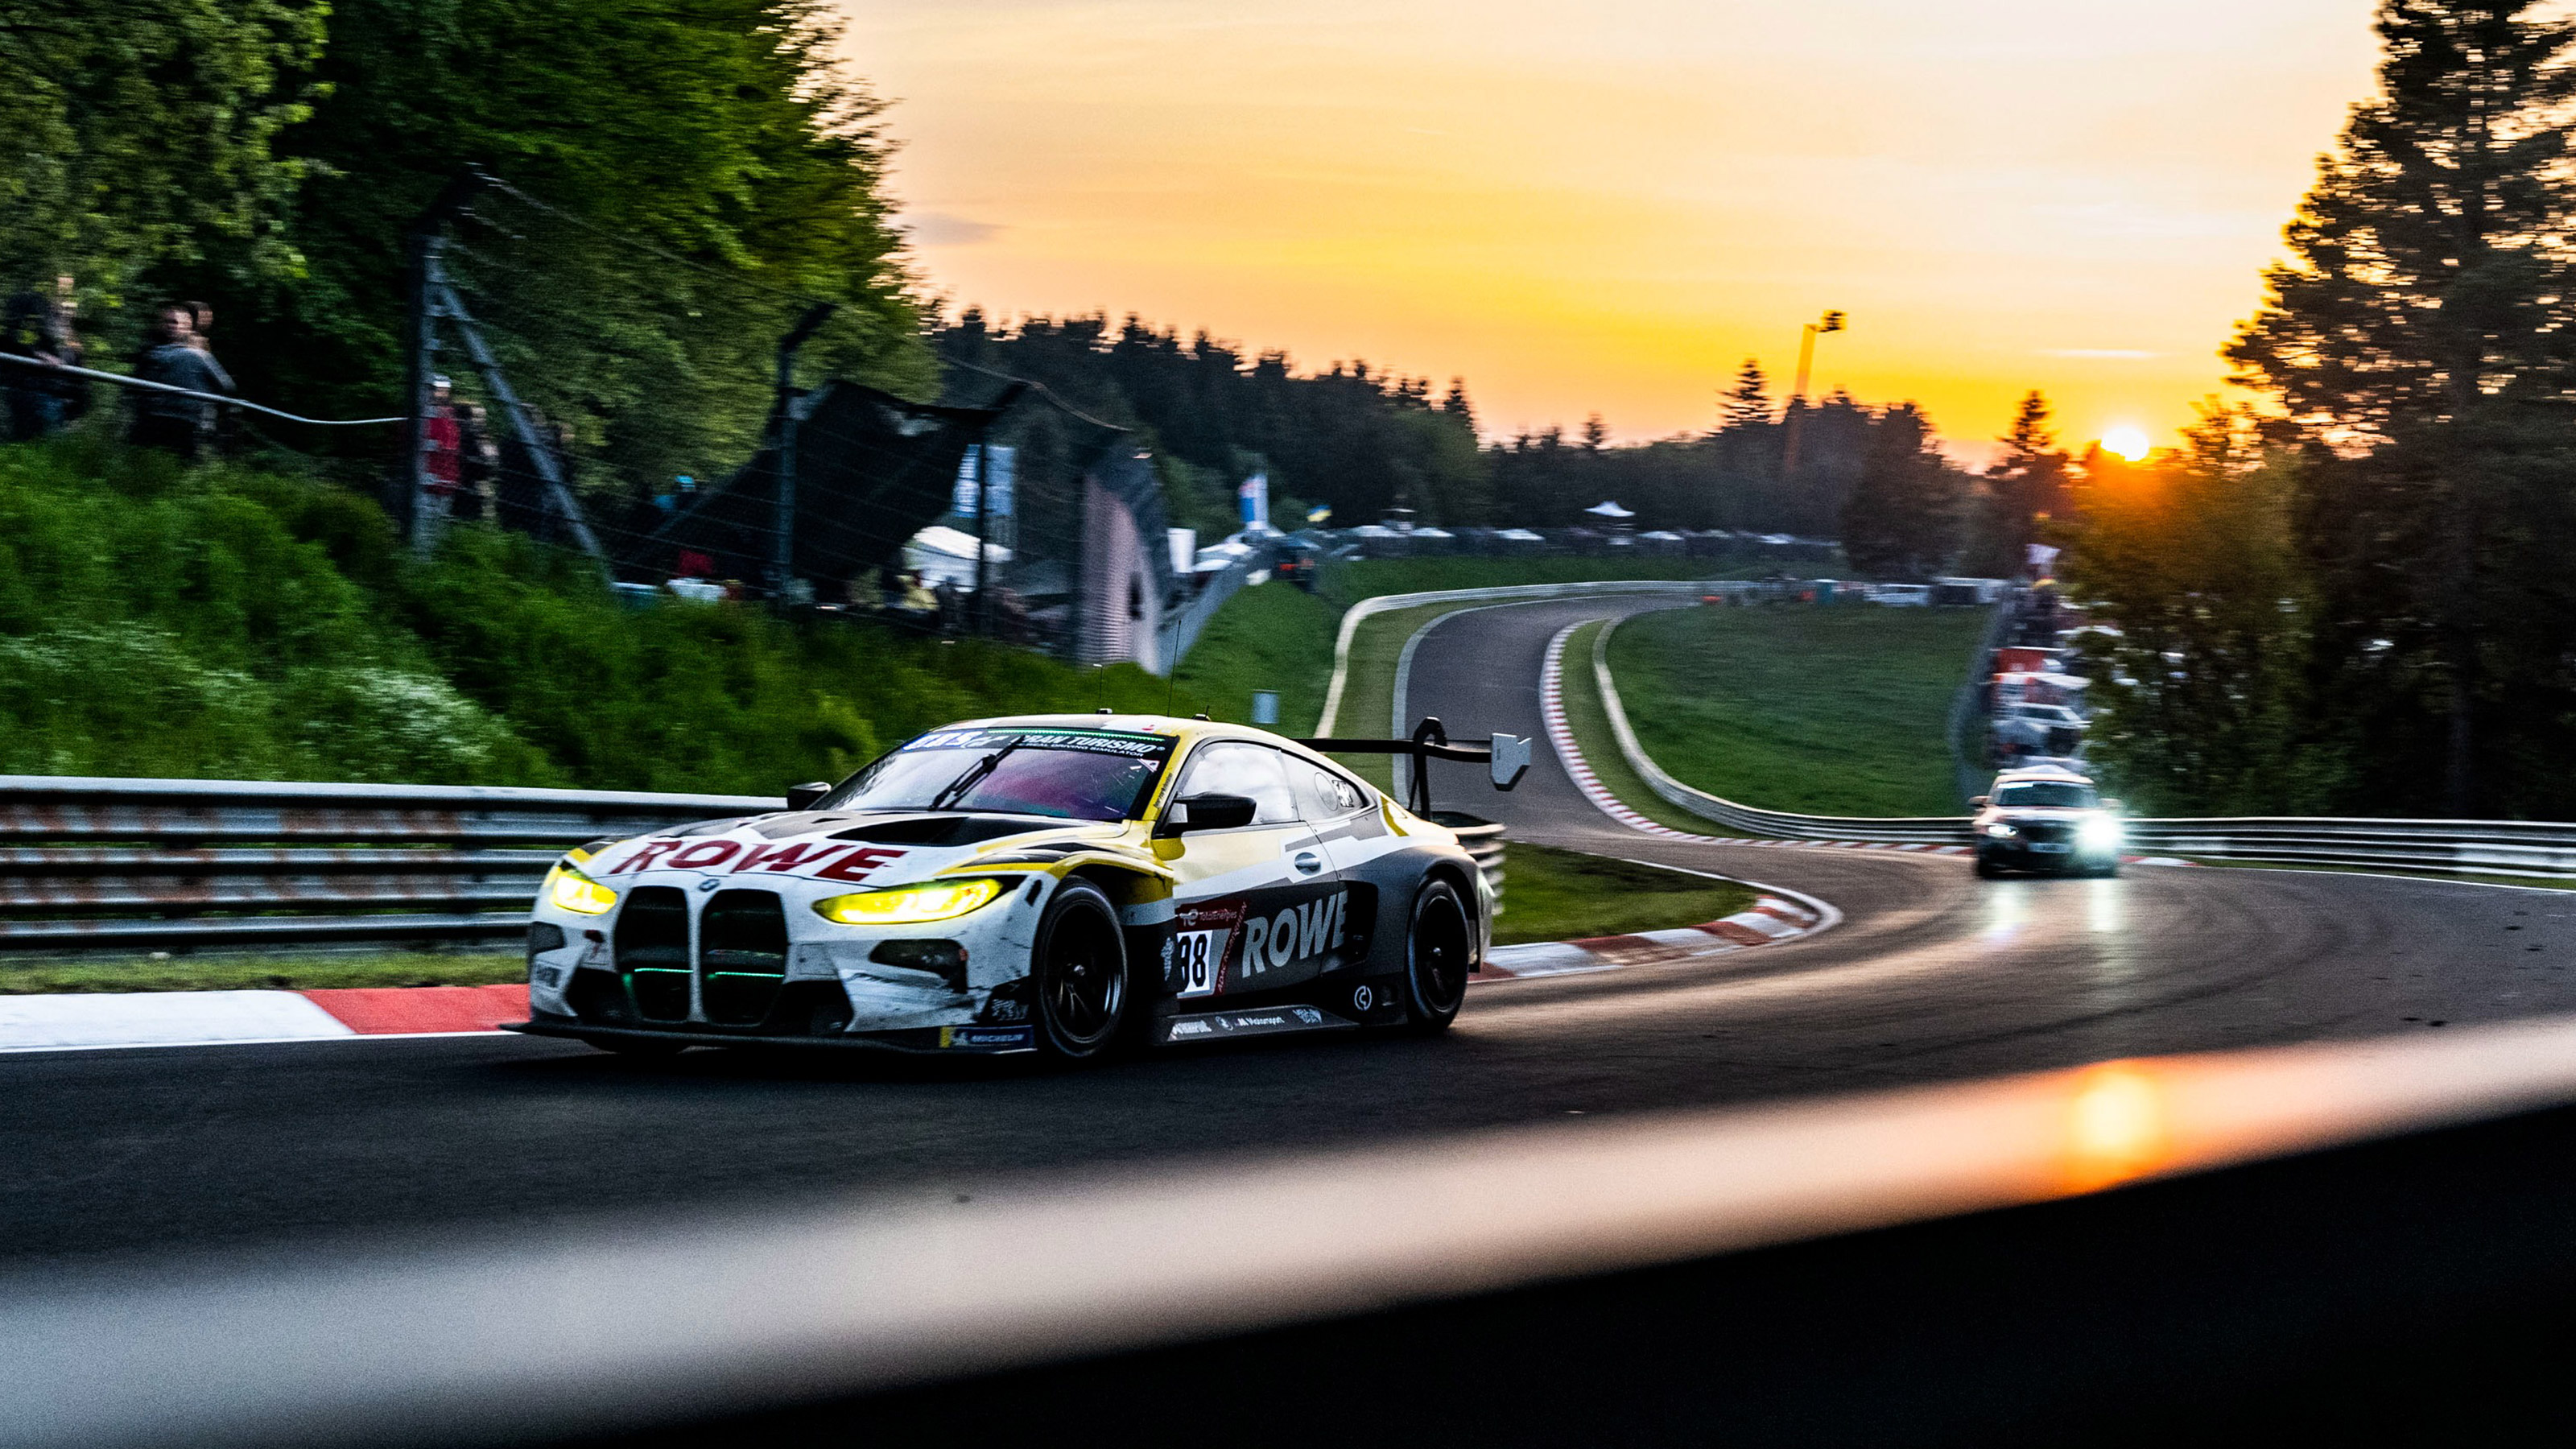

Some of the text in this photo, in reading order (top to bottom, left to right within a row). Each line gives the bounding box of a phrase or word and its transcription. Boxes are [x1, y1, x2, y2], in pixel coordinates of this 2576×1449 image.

[1067, 737, 1157, 753] TURISMO
[1090, 746, 1144, 757] SIMULATOR
[608, 840, 909, 881] ROWE
[1242, 890, 1348, 979] ROWE
